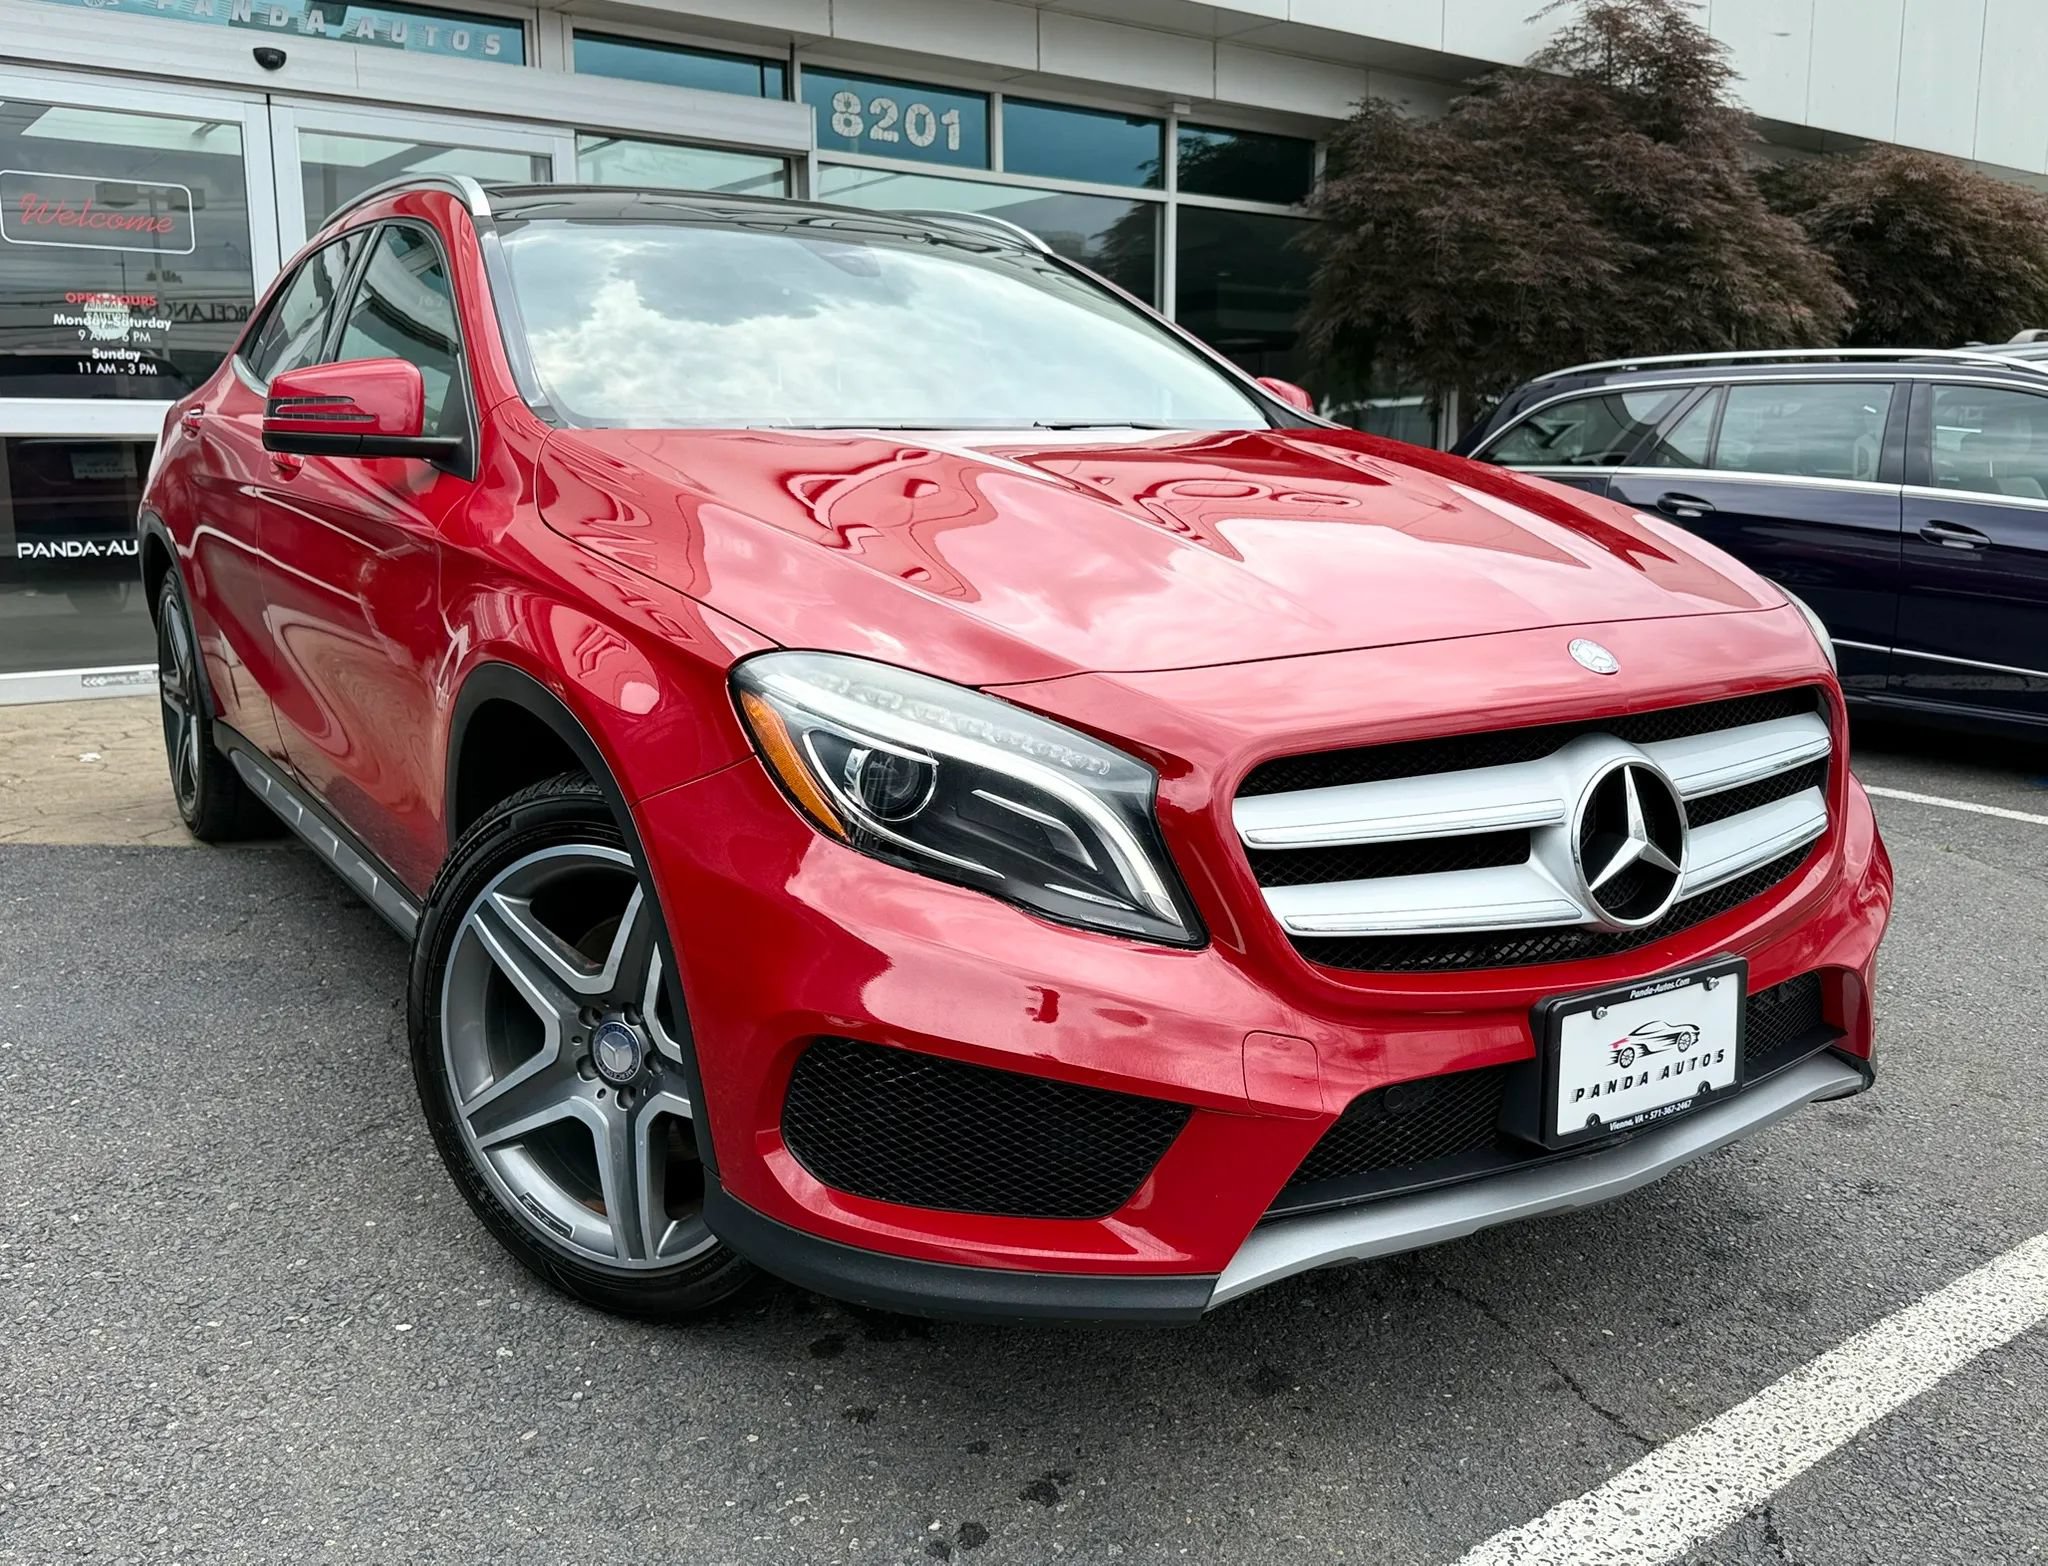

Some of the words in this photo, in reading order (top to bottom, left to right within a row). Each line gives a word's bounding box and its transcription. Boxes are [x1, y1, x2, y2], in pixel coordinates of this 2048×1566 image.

[355, 16, 501, 56] AUTOS
[832, 91, 960, 150] 8201
[18, 192, 176, 234] Welcome
[53, 313, 172, 331] Monday-Saturday
[78, 329, 87, 341] 9
[121, 331, 130, 343] 6
[133, 331, 151, 342] PM
[92, 347, 141, 362] Sunday
[78, 361, 91, 374] 11
[96, 363, 117, 374] AM
[128, 363, 136, 375] 3
[140, 364, 158, 375] PM
[1575, 1071, 1649, 1102] PANDA
[1660, 1049, 1725, 1080] AUTOS
[1635, 1114, 1644, 1124] VA
